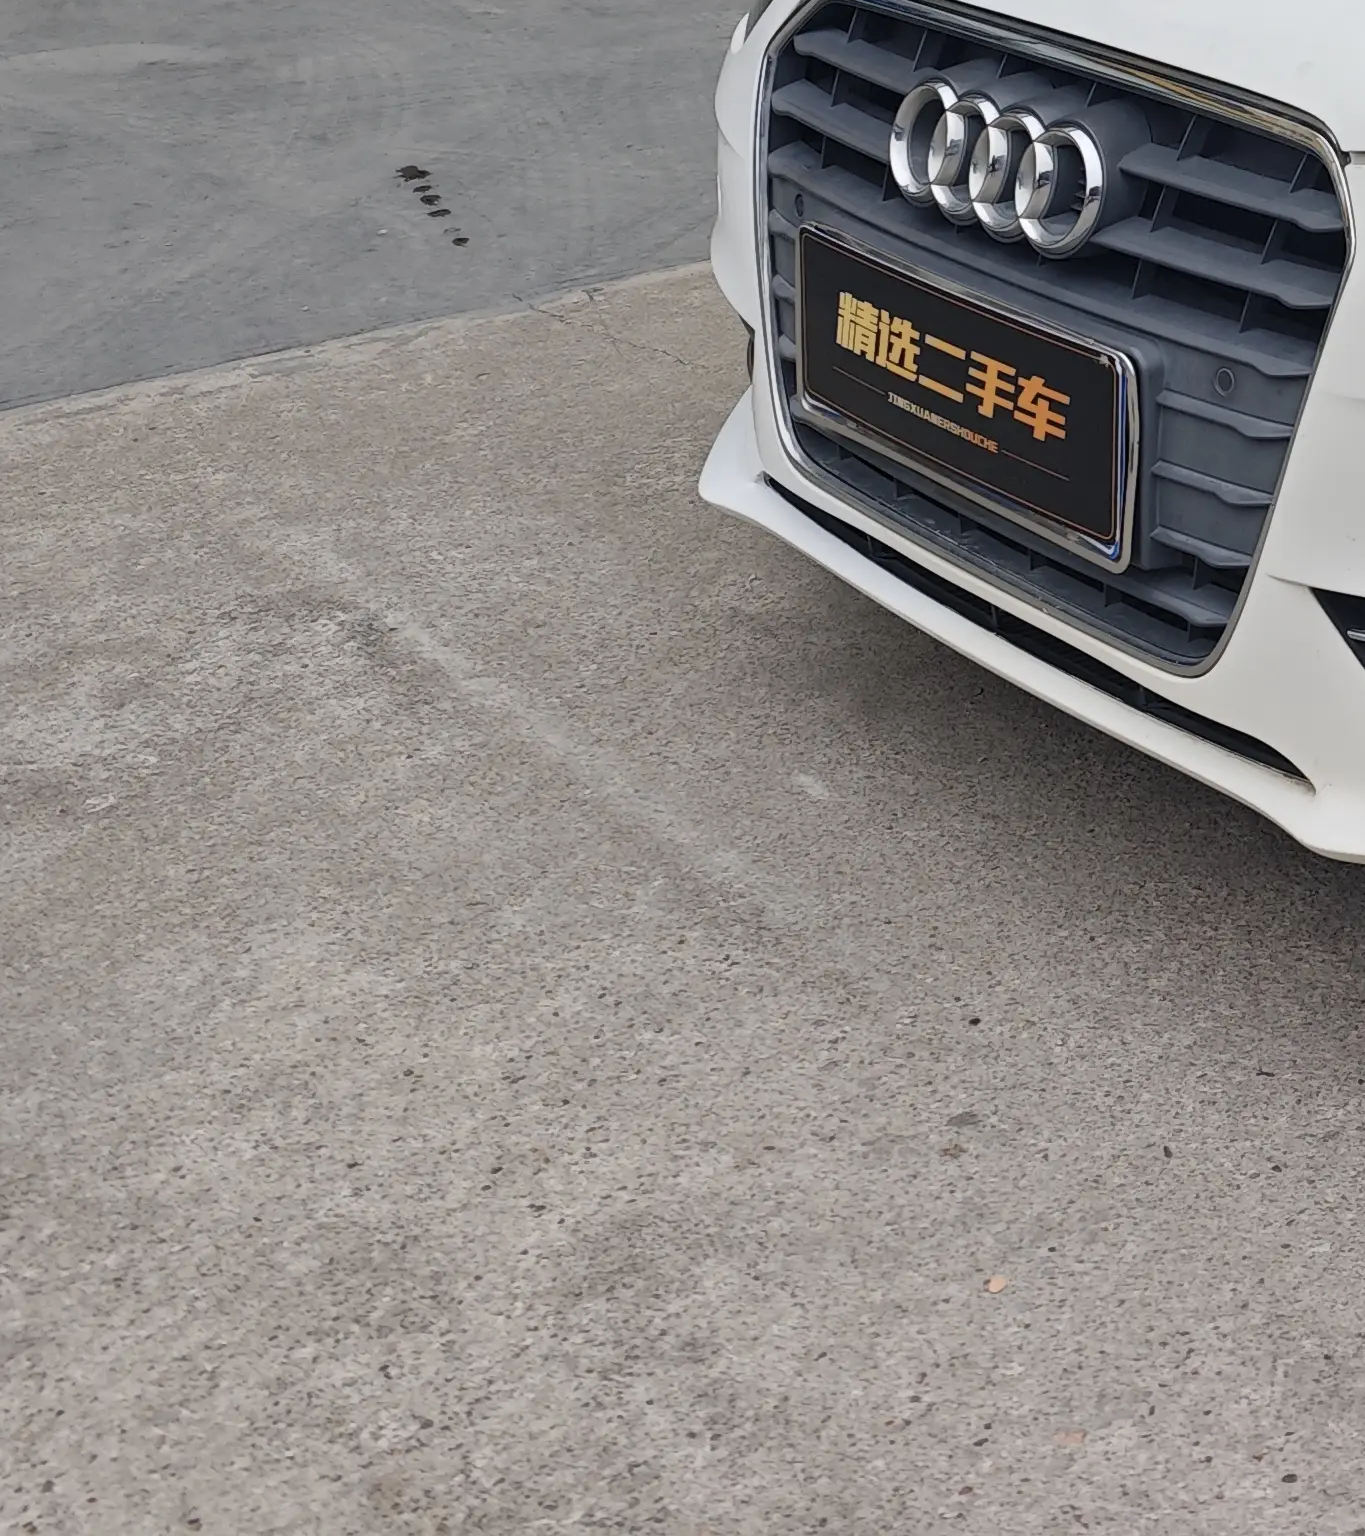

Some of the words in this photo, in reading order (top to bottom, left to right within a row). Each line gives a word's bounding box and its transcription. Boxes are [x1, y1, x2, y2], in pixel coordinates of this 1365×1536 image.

[835, 291, 1071, 442] 精选二手车
